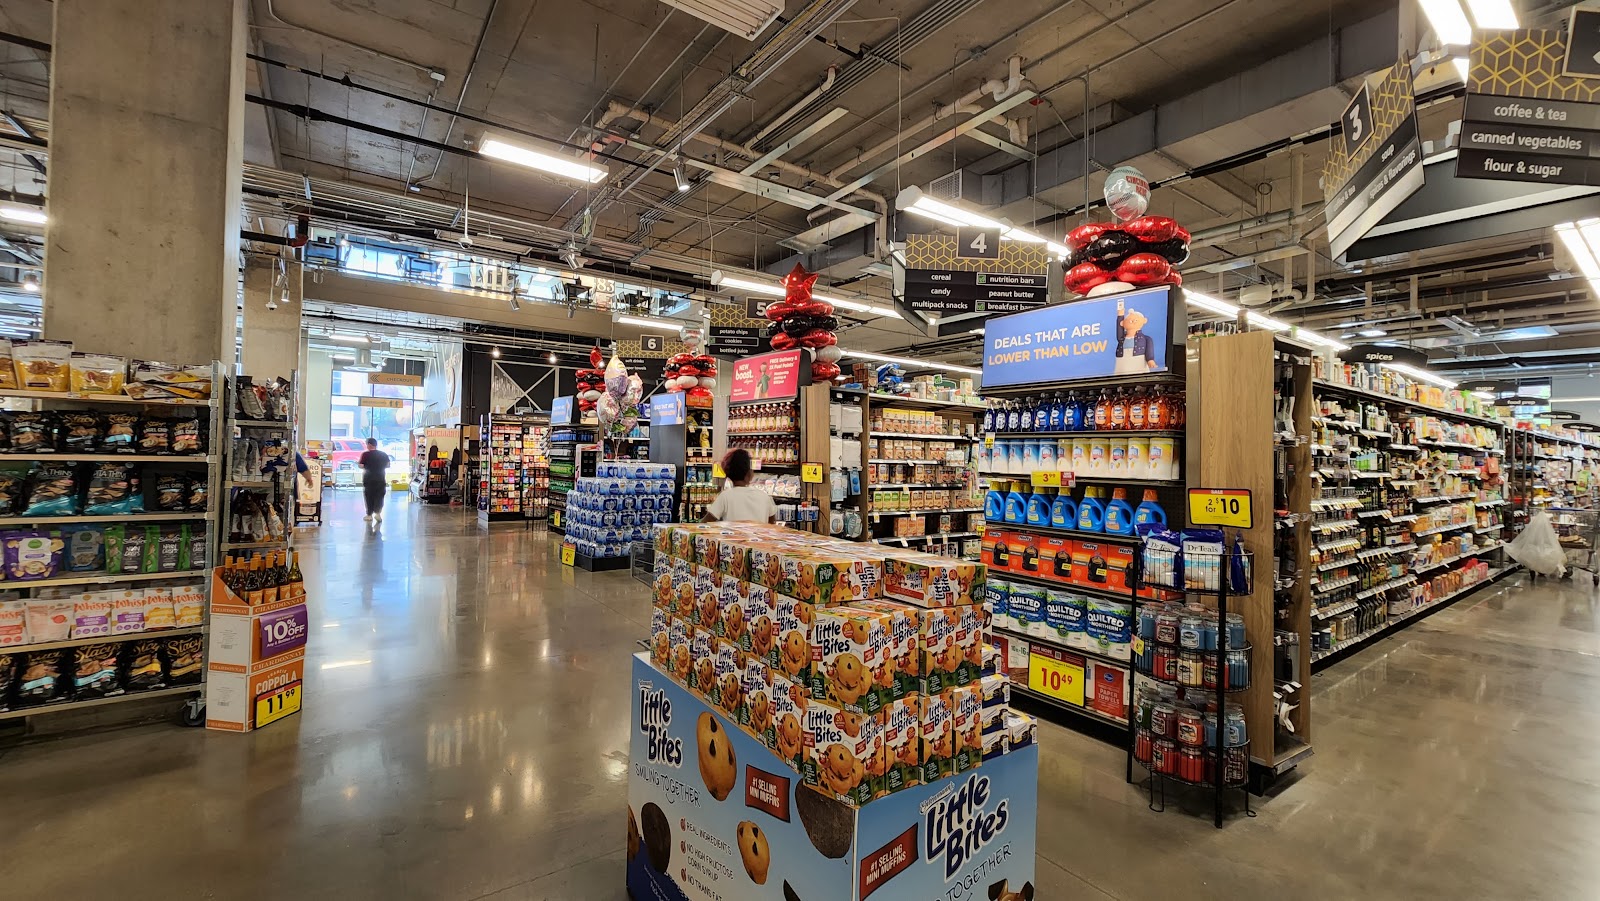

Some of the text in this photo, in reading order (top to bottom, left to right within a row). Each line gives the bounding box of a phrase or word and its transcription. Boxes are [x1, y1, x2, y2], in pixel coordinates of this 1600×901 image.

[1494, 103, 1567, 121] coffee & tea
[1350, 104, 1362, 141] 3
[1472, 131, 1582, 150] canned vegetables
[1381, 143, 1395, 163] soup
[1484, 158, 1562, 177] flour & sugar
[969, 233, 988, 255] 4
[931, 273, 951, 281] cereal
[989, 276, 1035, 285] nutrition bars
[931, 287, 951, 296] candy
[988, 290, 1035, 298] peanut butter
[755, 302, 767, 317] 5
[911, 300, 945, 309] multipack
[987, 302, 1019, 311] breakfast
[647, 338, 657, 350] 6
[994, 322, 1101, 350] DEALS THAT ARE
[988, 339, 1108, 366] LOWER THAN LOW
[1365, 352, 1394, 362] spices
[739, 363, 750, 371] NEW
[1137, 513, 1147, 522] all
[255, 597, 304, 613] CHARDONNAY
[1009, 595, 1041, 608] QUILTED
[1011, 603, 1036, 611] NORTHERN
[1047, 604, 1082, 618] QUILTED
[752, 605, 768, 618] Bites
[776, 602, 793, 622] Little
[961, 610, 978, 629] Little
[1050, 612, 1078, 621] NORTHERN
[1087, 613, 1125, 628] QUILTED
[264, 618, 305, 643] 10% OFF
[780, 616, 798, 632] Bites
[815, 620, 841, 644] Little
[932, 614, 950, 635] Little
[938, 623, 955, 640] Bites
[967, 618, 983, 635] Bites
[1091, 621, 1119, 632] NORTHERN
[823, 637, 850, 656] Bites
[253, 648, 304, 671] CHARDONNAY
[720, 660, 735, 673] Bites
[255, 671, 297, 695] COPPOLA
[749, 678, 765, 691] Bites
[772, 680, 789, 700] Little
[1098, 693, 1120, 705] TOWELS
[1099, 688, 1118, 699] PAPER
[641, 688, 671, 732] Little
[776, 696, 793, 712] Bites
[928, 699, 946, 721] Little
[960, 693, 977, 714] Little
[965, 701, 982, 719] Bites
[808, 709, 833, 731] Little
[891, 705, 910, 727] Little
[897, 713, 918, 734] Bites
[934, 708, 952, 727] Bites
[815, 726, 842, 744] Bites
[648, 725, 682, 765] Bites
[635, 763, 701, 808] SMILING TOGETHER
[752, 776, 777, 796] #1 SELLING
[749, 785, 780, 808] MINI MUFFINS
[926, 773, 989, 860] Little
[686, 821, 733, 856] REAL INGREDIENTS
[945, 800, 1008, 880] Bites
[686, 843, 734, 880] NO HIGH FRUCTOSE
[870, 844, 903, 872] #1 SELLING
[687, 856, 719, 882] CORN SYRUP
[866, 851, 907, 886] MINI MUFFINS
[946, 844, 1012, 900] TOGETHER
[687, 874, 695, 886] NO
[695, 879, 712, 899] TRANS
